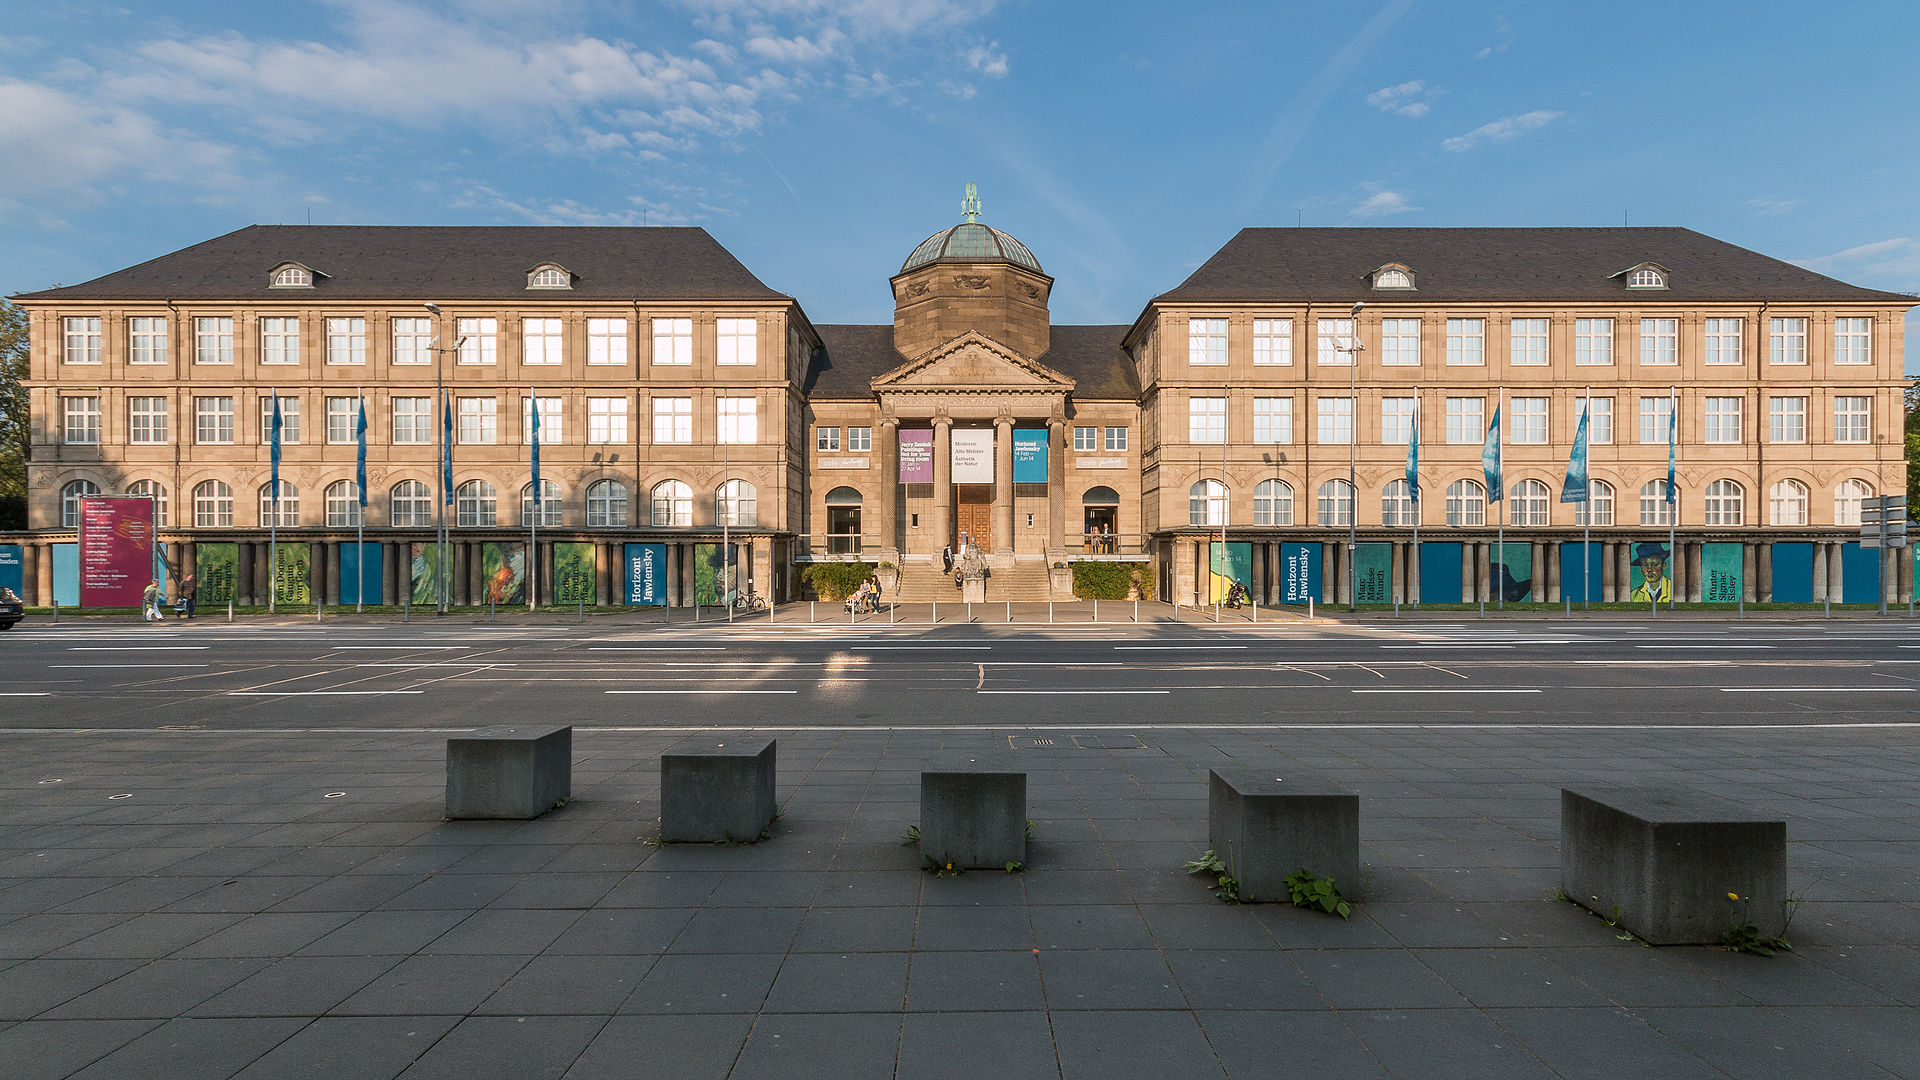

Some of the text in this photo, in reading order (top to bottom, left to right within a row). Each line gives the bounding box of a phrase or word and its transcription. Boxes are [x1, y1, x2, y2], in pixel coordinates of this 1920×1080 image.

[277, 549, 285, 582] Dongen
[286, 564, 295, 601] Gauguin
[296, 560, 304, 582] Gogh
[572, 554, 580, 600] Kandinsky
[632, 557, 641, 602] Horizont
[644, 548, 654, 602] Jawlensky
[1288, 556, 1297, 601] Horizont
[1299, 547, 1310, 601] Jawlensky
[1367, 568, 1375, 600] Matisse
[1719, 573, 1728, 600] Signac
[1728, 576, 1737, 601] Sisley
